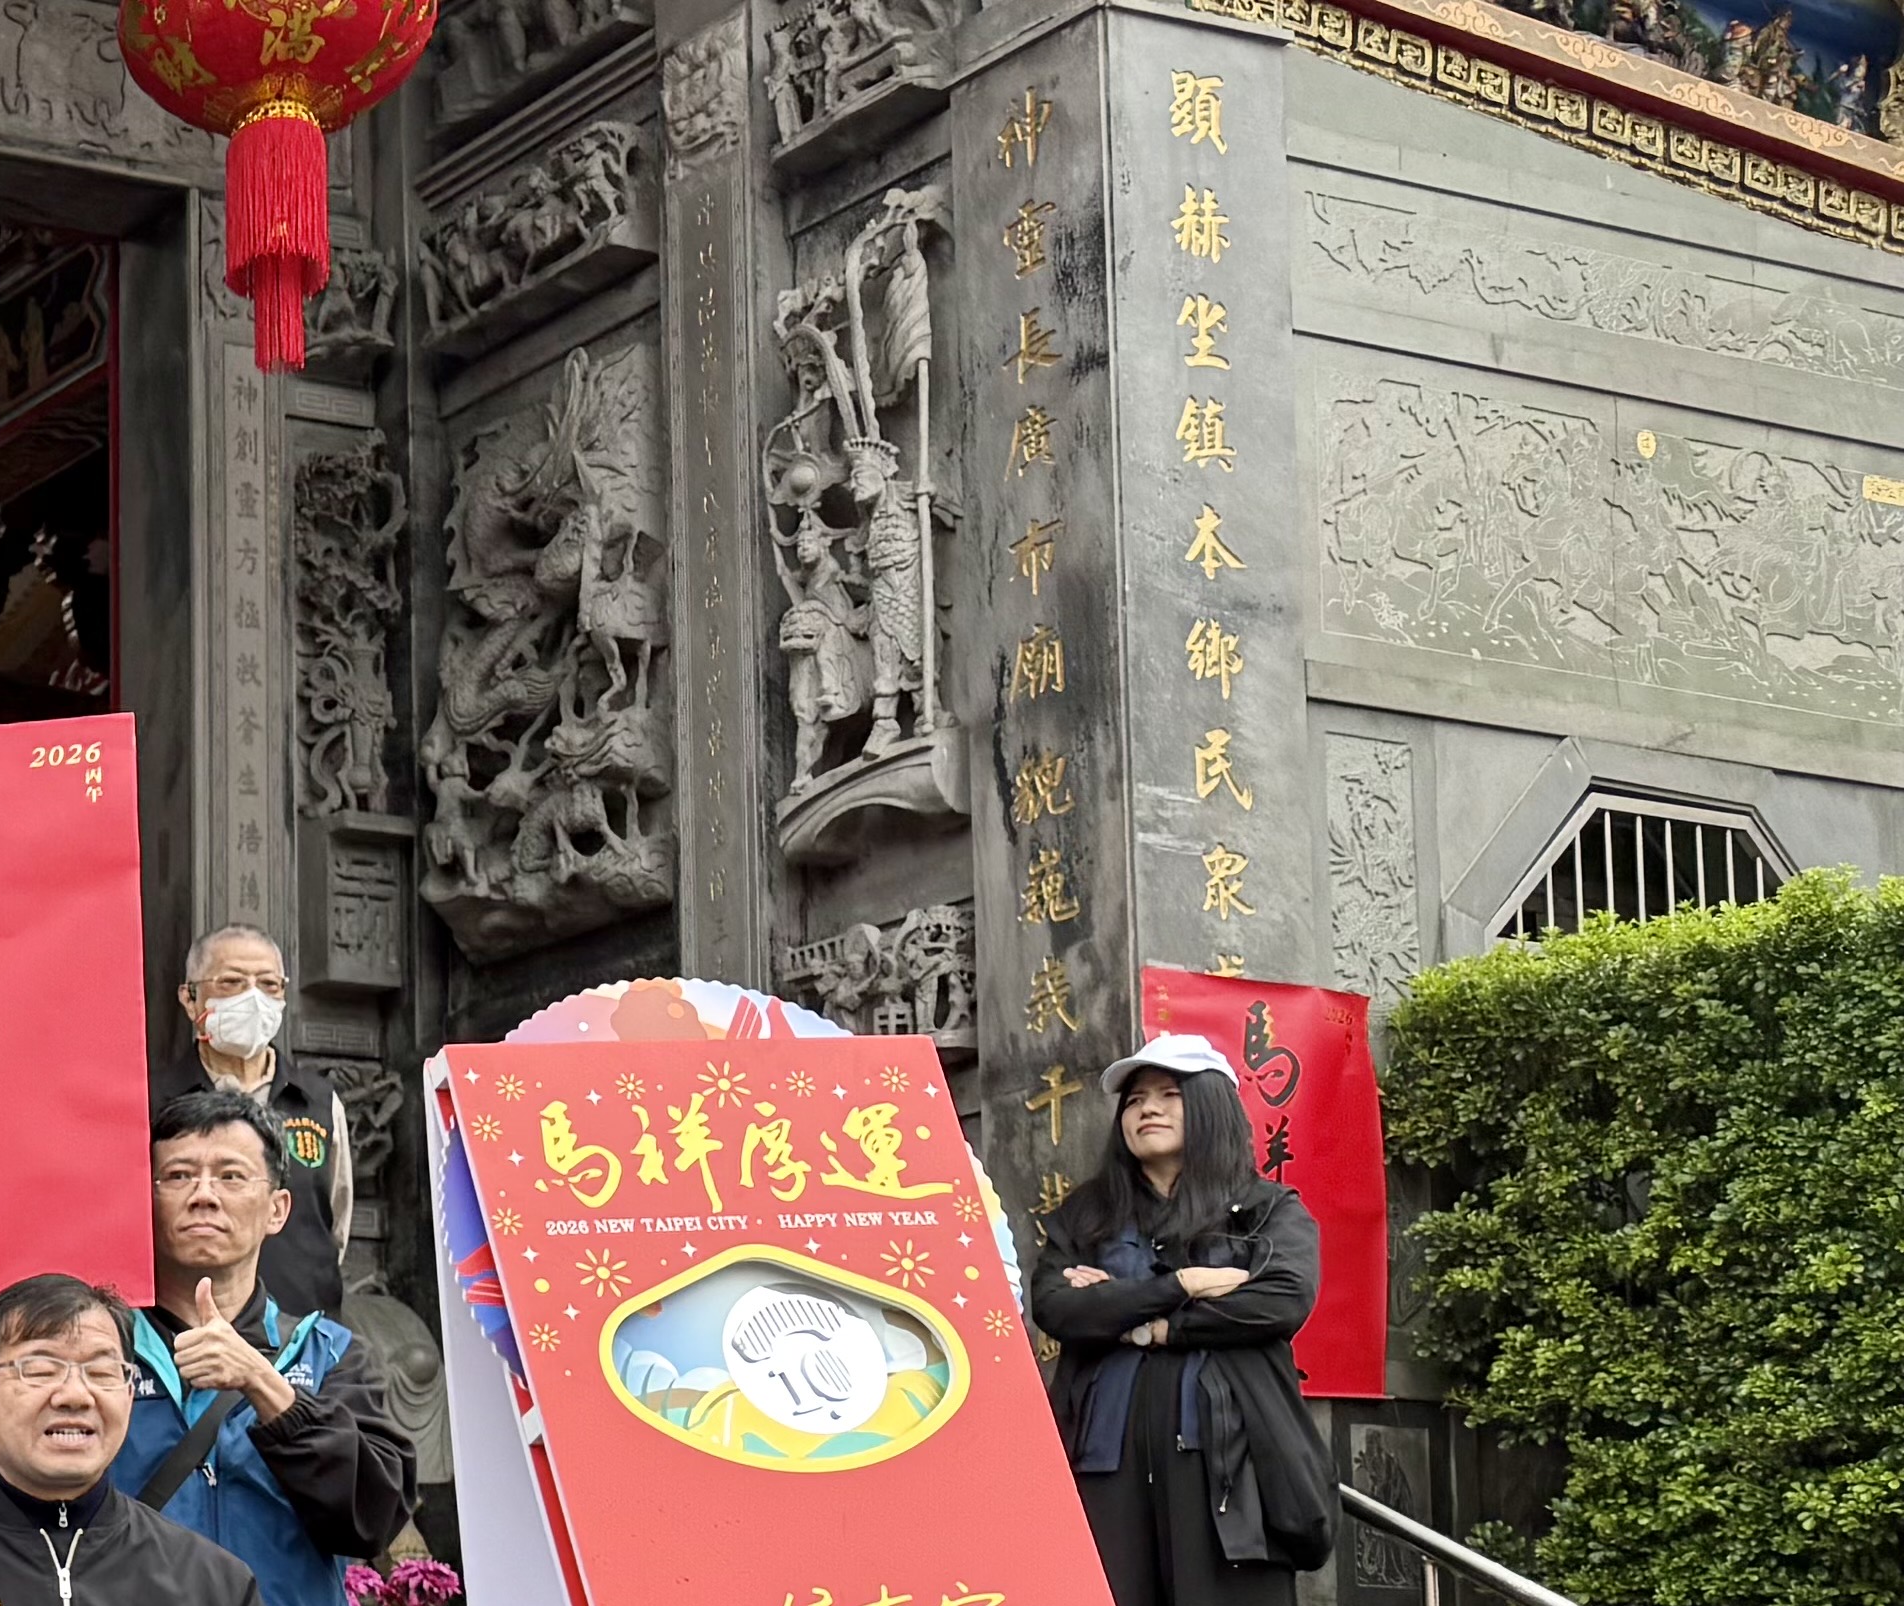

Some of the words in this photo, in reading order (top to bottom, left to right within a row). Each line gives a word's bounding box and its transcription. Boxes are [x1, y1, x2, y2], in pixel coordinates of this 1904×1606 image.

[29, 741, 102, 768] 2026
[533, 1092, 954, 1214] 馬祥厚運
[545, 1218, 590, 1236] 2026
[594, 1216, 635, 1234] NEW
[640, 1214, 703, 1232] TAIPEI
[707, 1213, 749, 1231] CITY
[778, 1211, 838, 1229] HAPPY
[844, 1211, 884, 1228] NEW
[888, 1210, 940, 1227] YEAR
